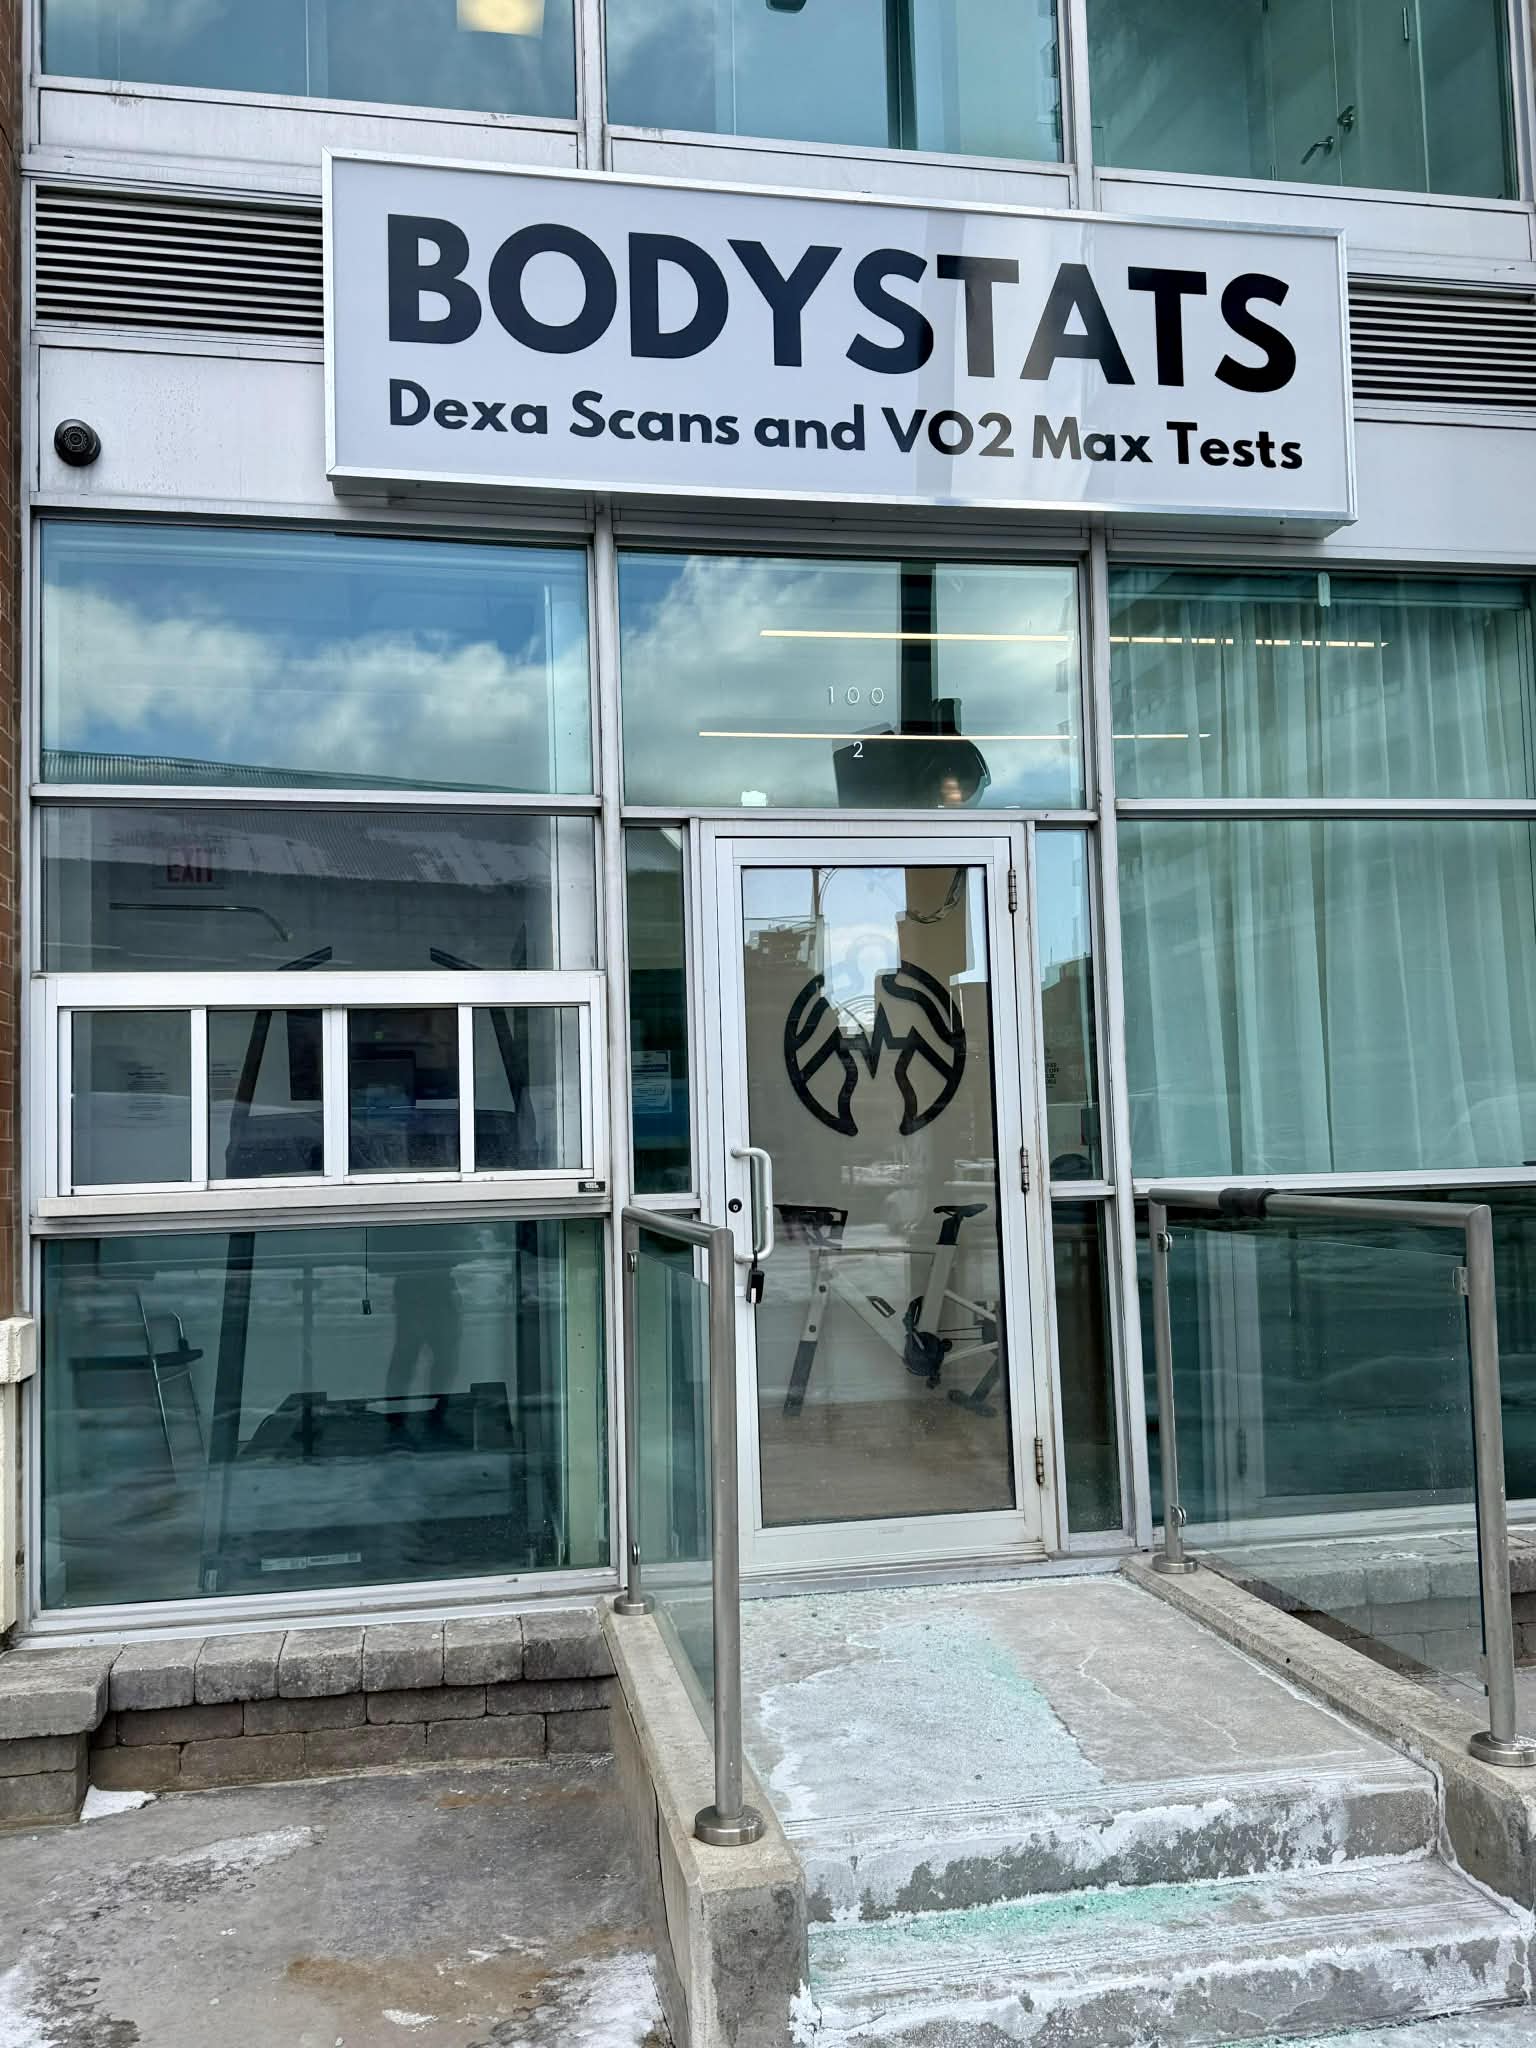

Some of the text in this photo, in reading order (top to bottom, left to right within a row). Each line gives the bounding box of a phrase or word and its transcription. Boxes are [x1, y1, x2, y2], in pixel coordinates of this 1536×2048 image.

[388, 214, 1297, 394] BODYSTATS
[389, 378, 1303, 470] Dexa Scans and VO2 Max Tests
[828, 686, 885, 704] 100
[852, 740, 864, 758] 2
